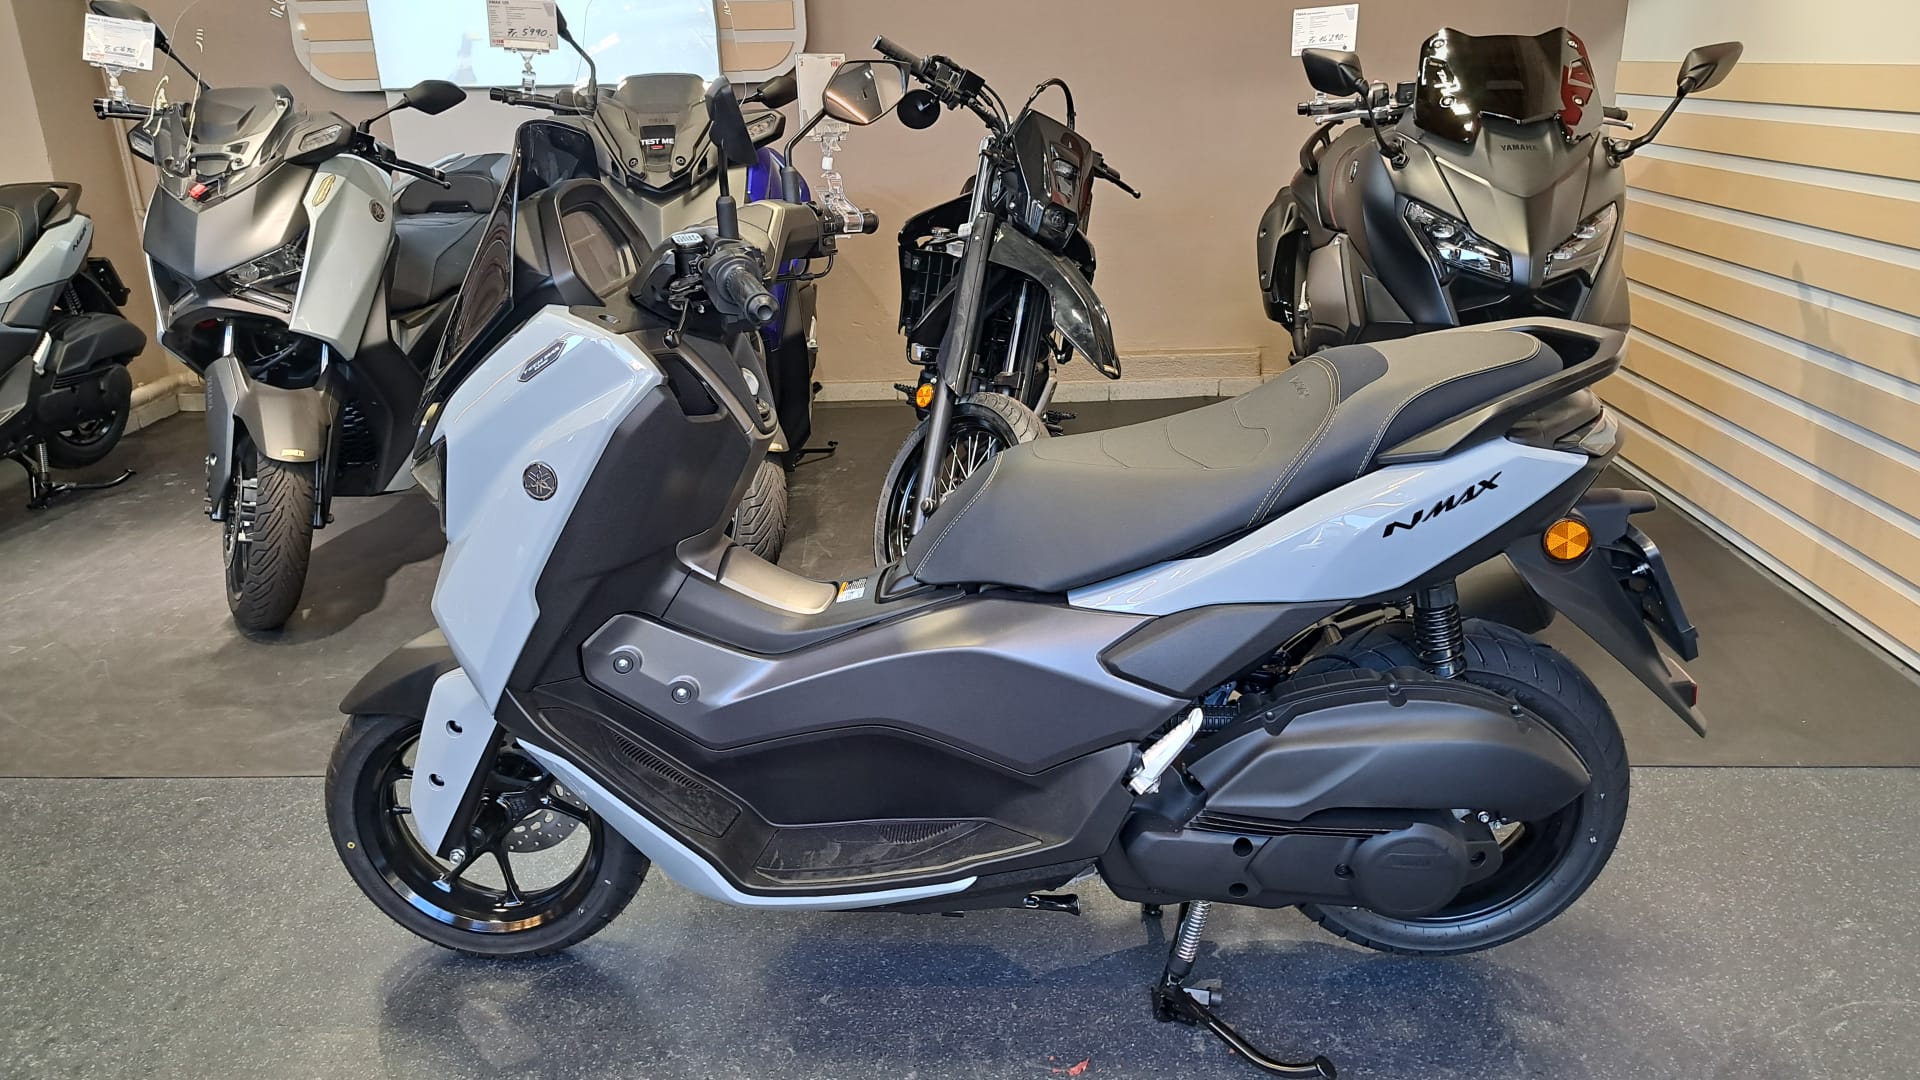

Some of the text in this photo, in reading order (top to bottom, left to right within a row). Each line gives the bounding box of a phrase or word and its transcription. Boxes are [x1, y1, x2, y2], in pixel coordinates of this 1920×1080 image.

[640, 137, 675, 146] TEST ME
[1382, 471, 1502, 538] NMAX
